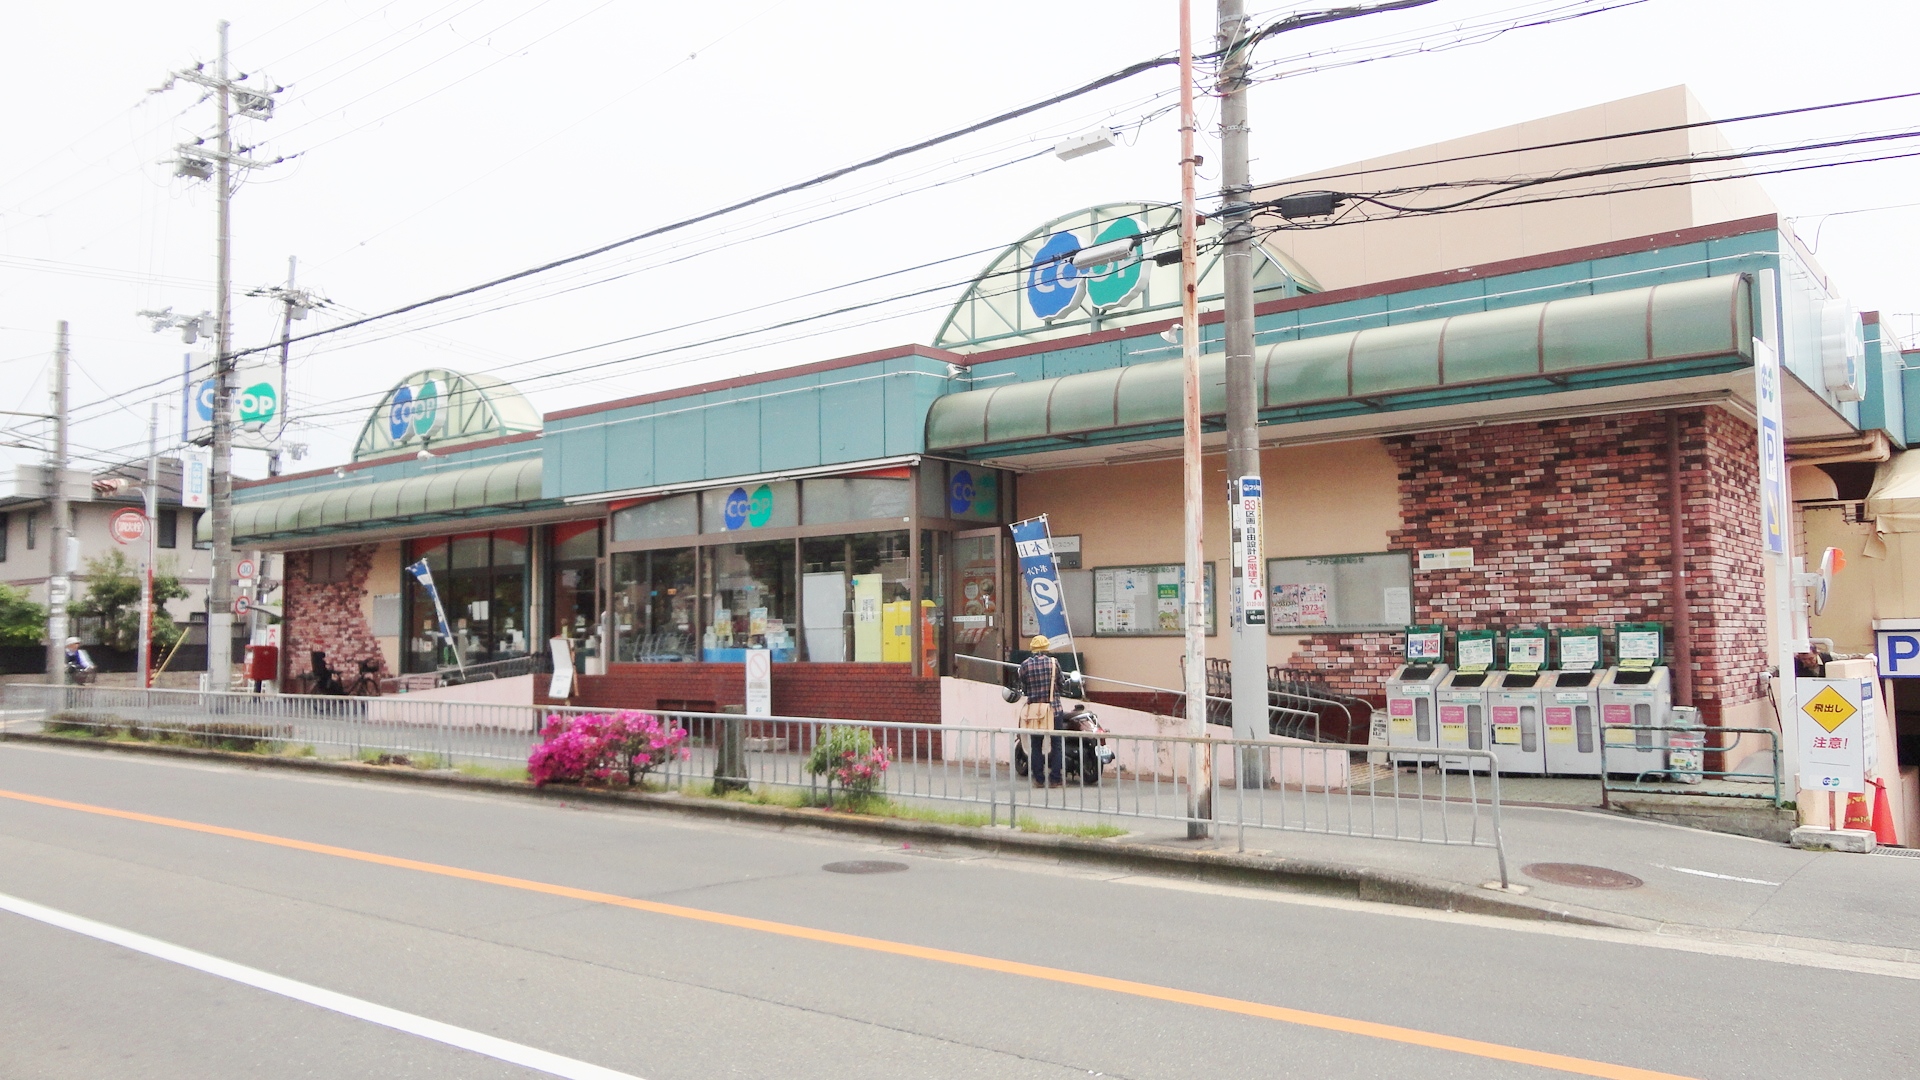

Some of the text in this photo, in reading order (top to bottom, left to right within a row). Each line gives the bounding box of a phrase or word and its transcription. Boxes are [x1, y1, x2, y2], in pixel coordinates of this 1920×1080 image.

[241, 565, 251, 574] 30
[1887, 635, 1920, 672] P
[1813, 703, 1844, 713] 飛出し
[1813, 736, 1849, 749] 注意!
